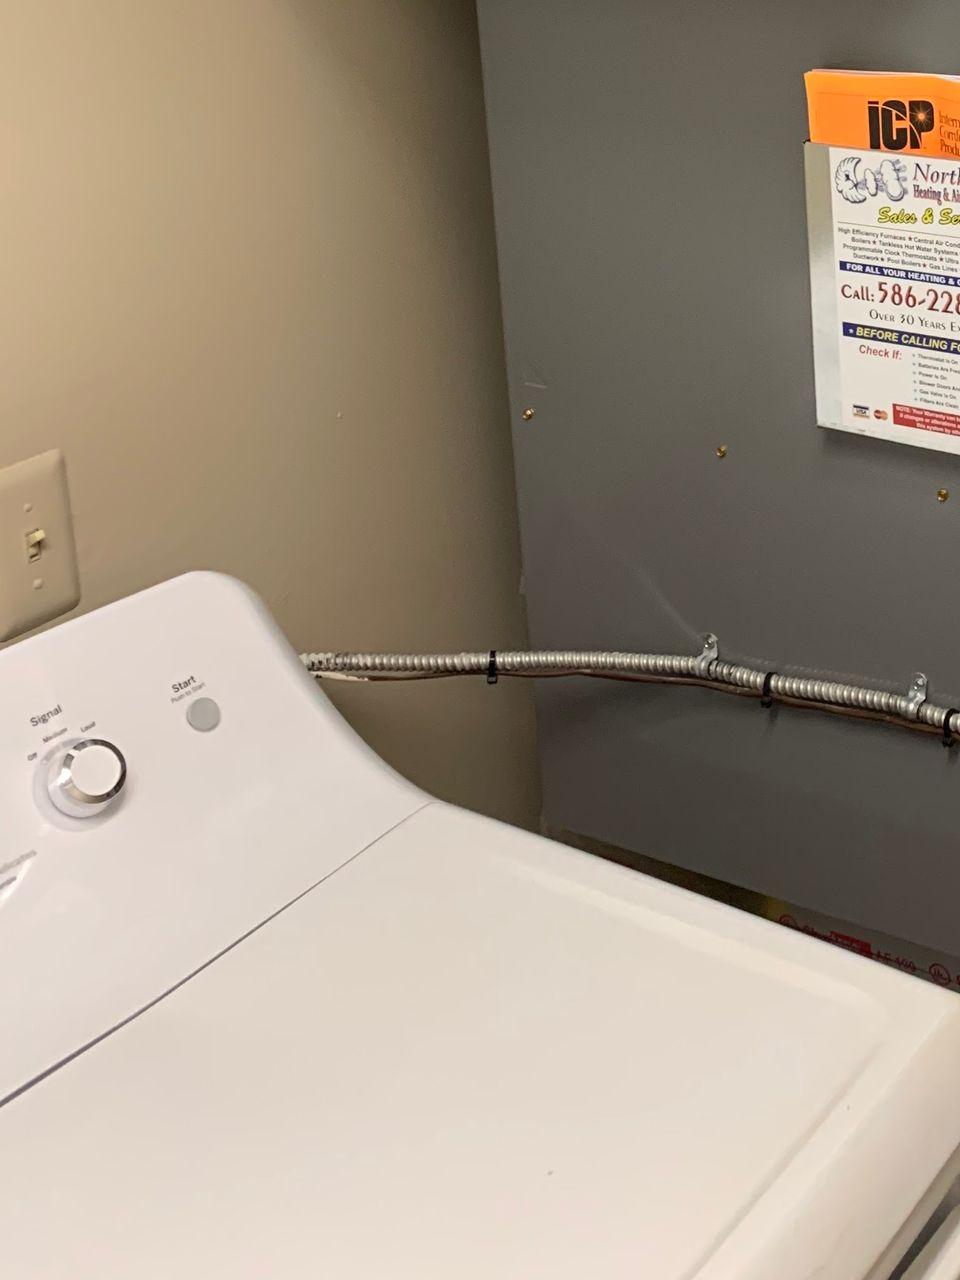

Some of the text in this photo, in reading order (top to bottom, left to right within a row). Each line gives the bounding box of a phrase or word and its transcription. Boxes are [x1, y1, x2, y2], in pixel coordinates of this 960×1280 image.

[913, 185, 942, 205] Heating
[943, 189, 949, 201] &
[878, 206, 917, 224] Sales
[922, 208, 934, 224] &
[838, 227, 850, 235] High
[852, 228, 879, 238] Efficiency
[880, 232, 906, 241] Furnaces
[913, 236, 934, 245] Central
[843, 243, 883, 254] Programmable
[902, 251, 937, 261] Thermostats
[945, 257, 959, 265] Ultra
[851, 237, 871, 245] Boilers
[879, 241, 903, 249] Tankless
[916, 245, 932, 253] Water
[933, 247, 958, 256] Systems
[853, 253, 879, 261] Ductwork
[901, 259, 921, 267] Boilers
[942, 265, 958, 273] Lines
[846, 263, 863, 271] FOR
[865, 266, 880, 274] ALL
[882, 268, 906, 278] YOUR
[908, 272, 946, 284] HEATING
[900, 314, 914, 325] 30
[856, 327, 899, 342] BEFORE
[901, 334, 948, 350] CALLING
[859, 345, 902, 360] Check If:
[171, 675, 197, 693] Start
[30, 703, 62, 727] Signal
